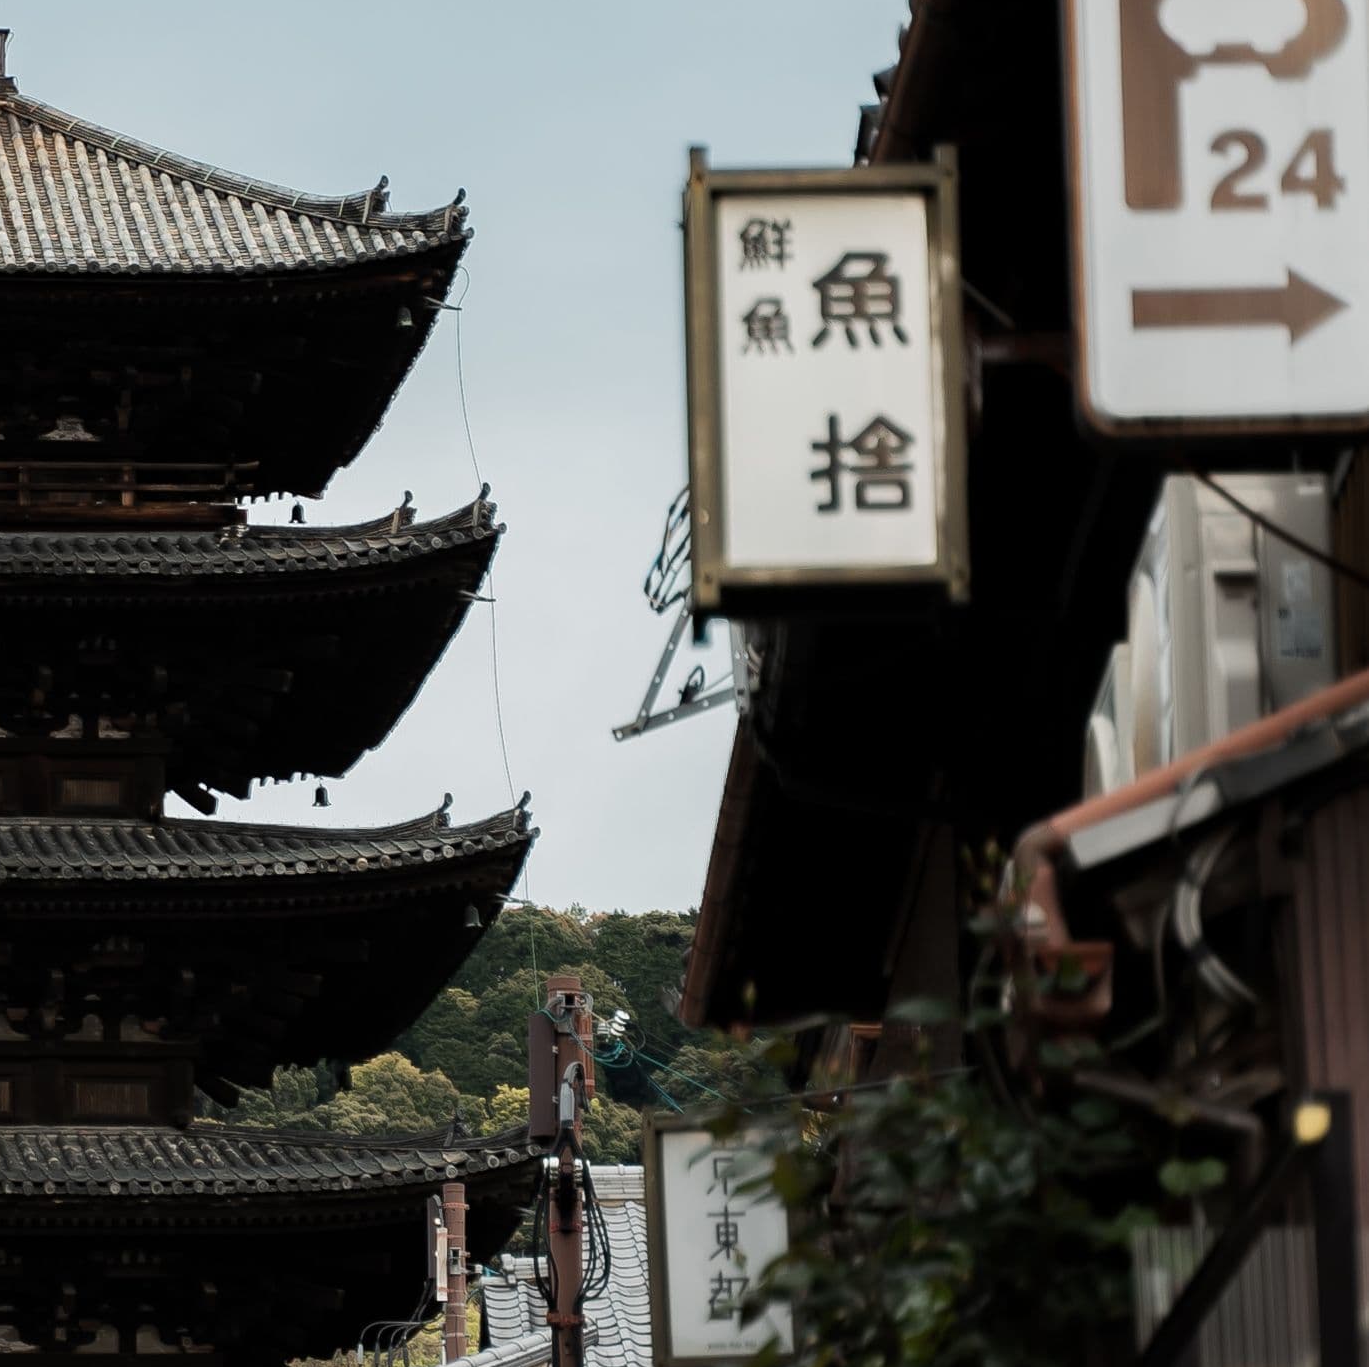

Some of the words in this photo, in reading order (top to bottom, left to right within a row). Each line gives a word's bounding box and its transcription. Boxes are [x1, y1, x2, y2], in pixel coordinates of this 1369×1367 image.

[1208, 127, 1346, 212] 24
[737, 217, 795, 356] 鮮魚
[809, 249, 916, 516] 魚捨
